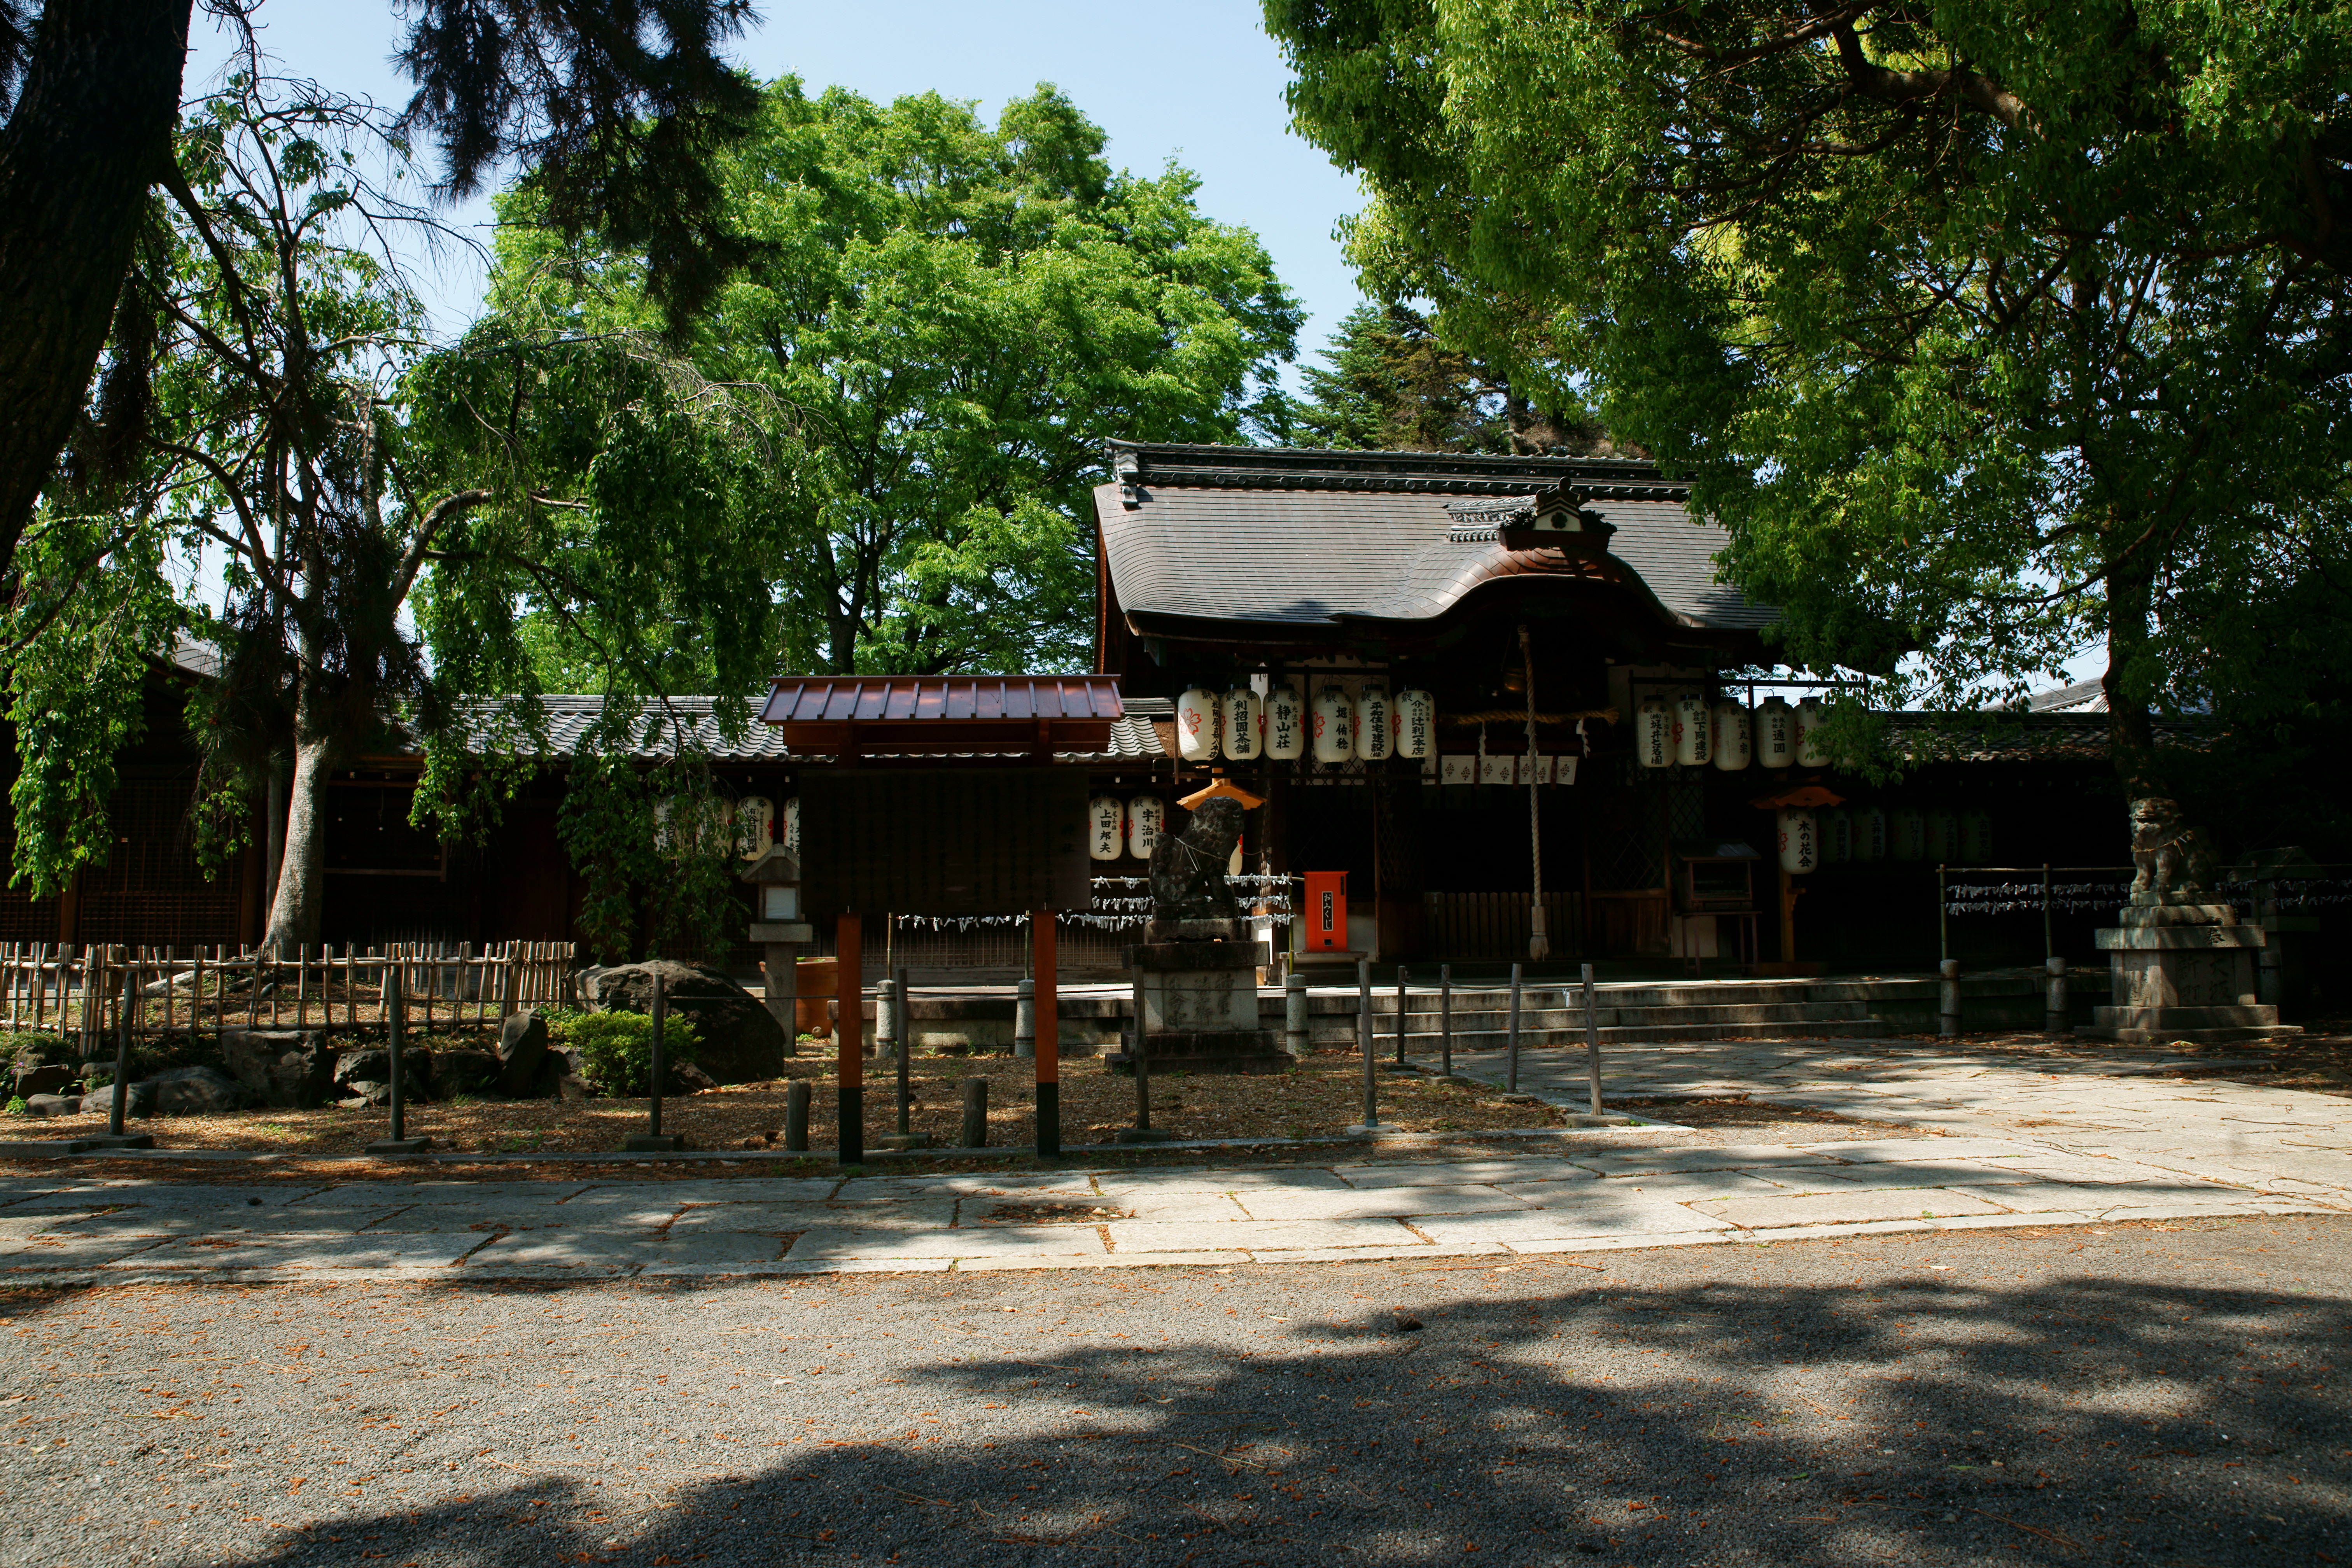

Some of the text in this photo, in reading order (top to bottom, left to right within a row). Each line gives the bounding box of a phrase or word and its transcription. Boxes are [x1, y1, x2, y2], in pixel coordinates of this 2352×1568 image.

[1275, 704, 1292, 749] 静山荘
[1411, 716, 1426, 756] 辻利一本店
[1694, 721, 1707, 761] 下岡建設
[1739, 730, 1748, 754] 丸宗
[1099, 808, 1112, 853] 上田邦夫
[1141, 808, 1155, 848] 宇治川
[1797, 820, 1812, 868] 木の花会
[1323, 893, 1332, 929] おみくじ
[2205, 928, 2225, 945] 奉
